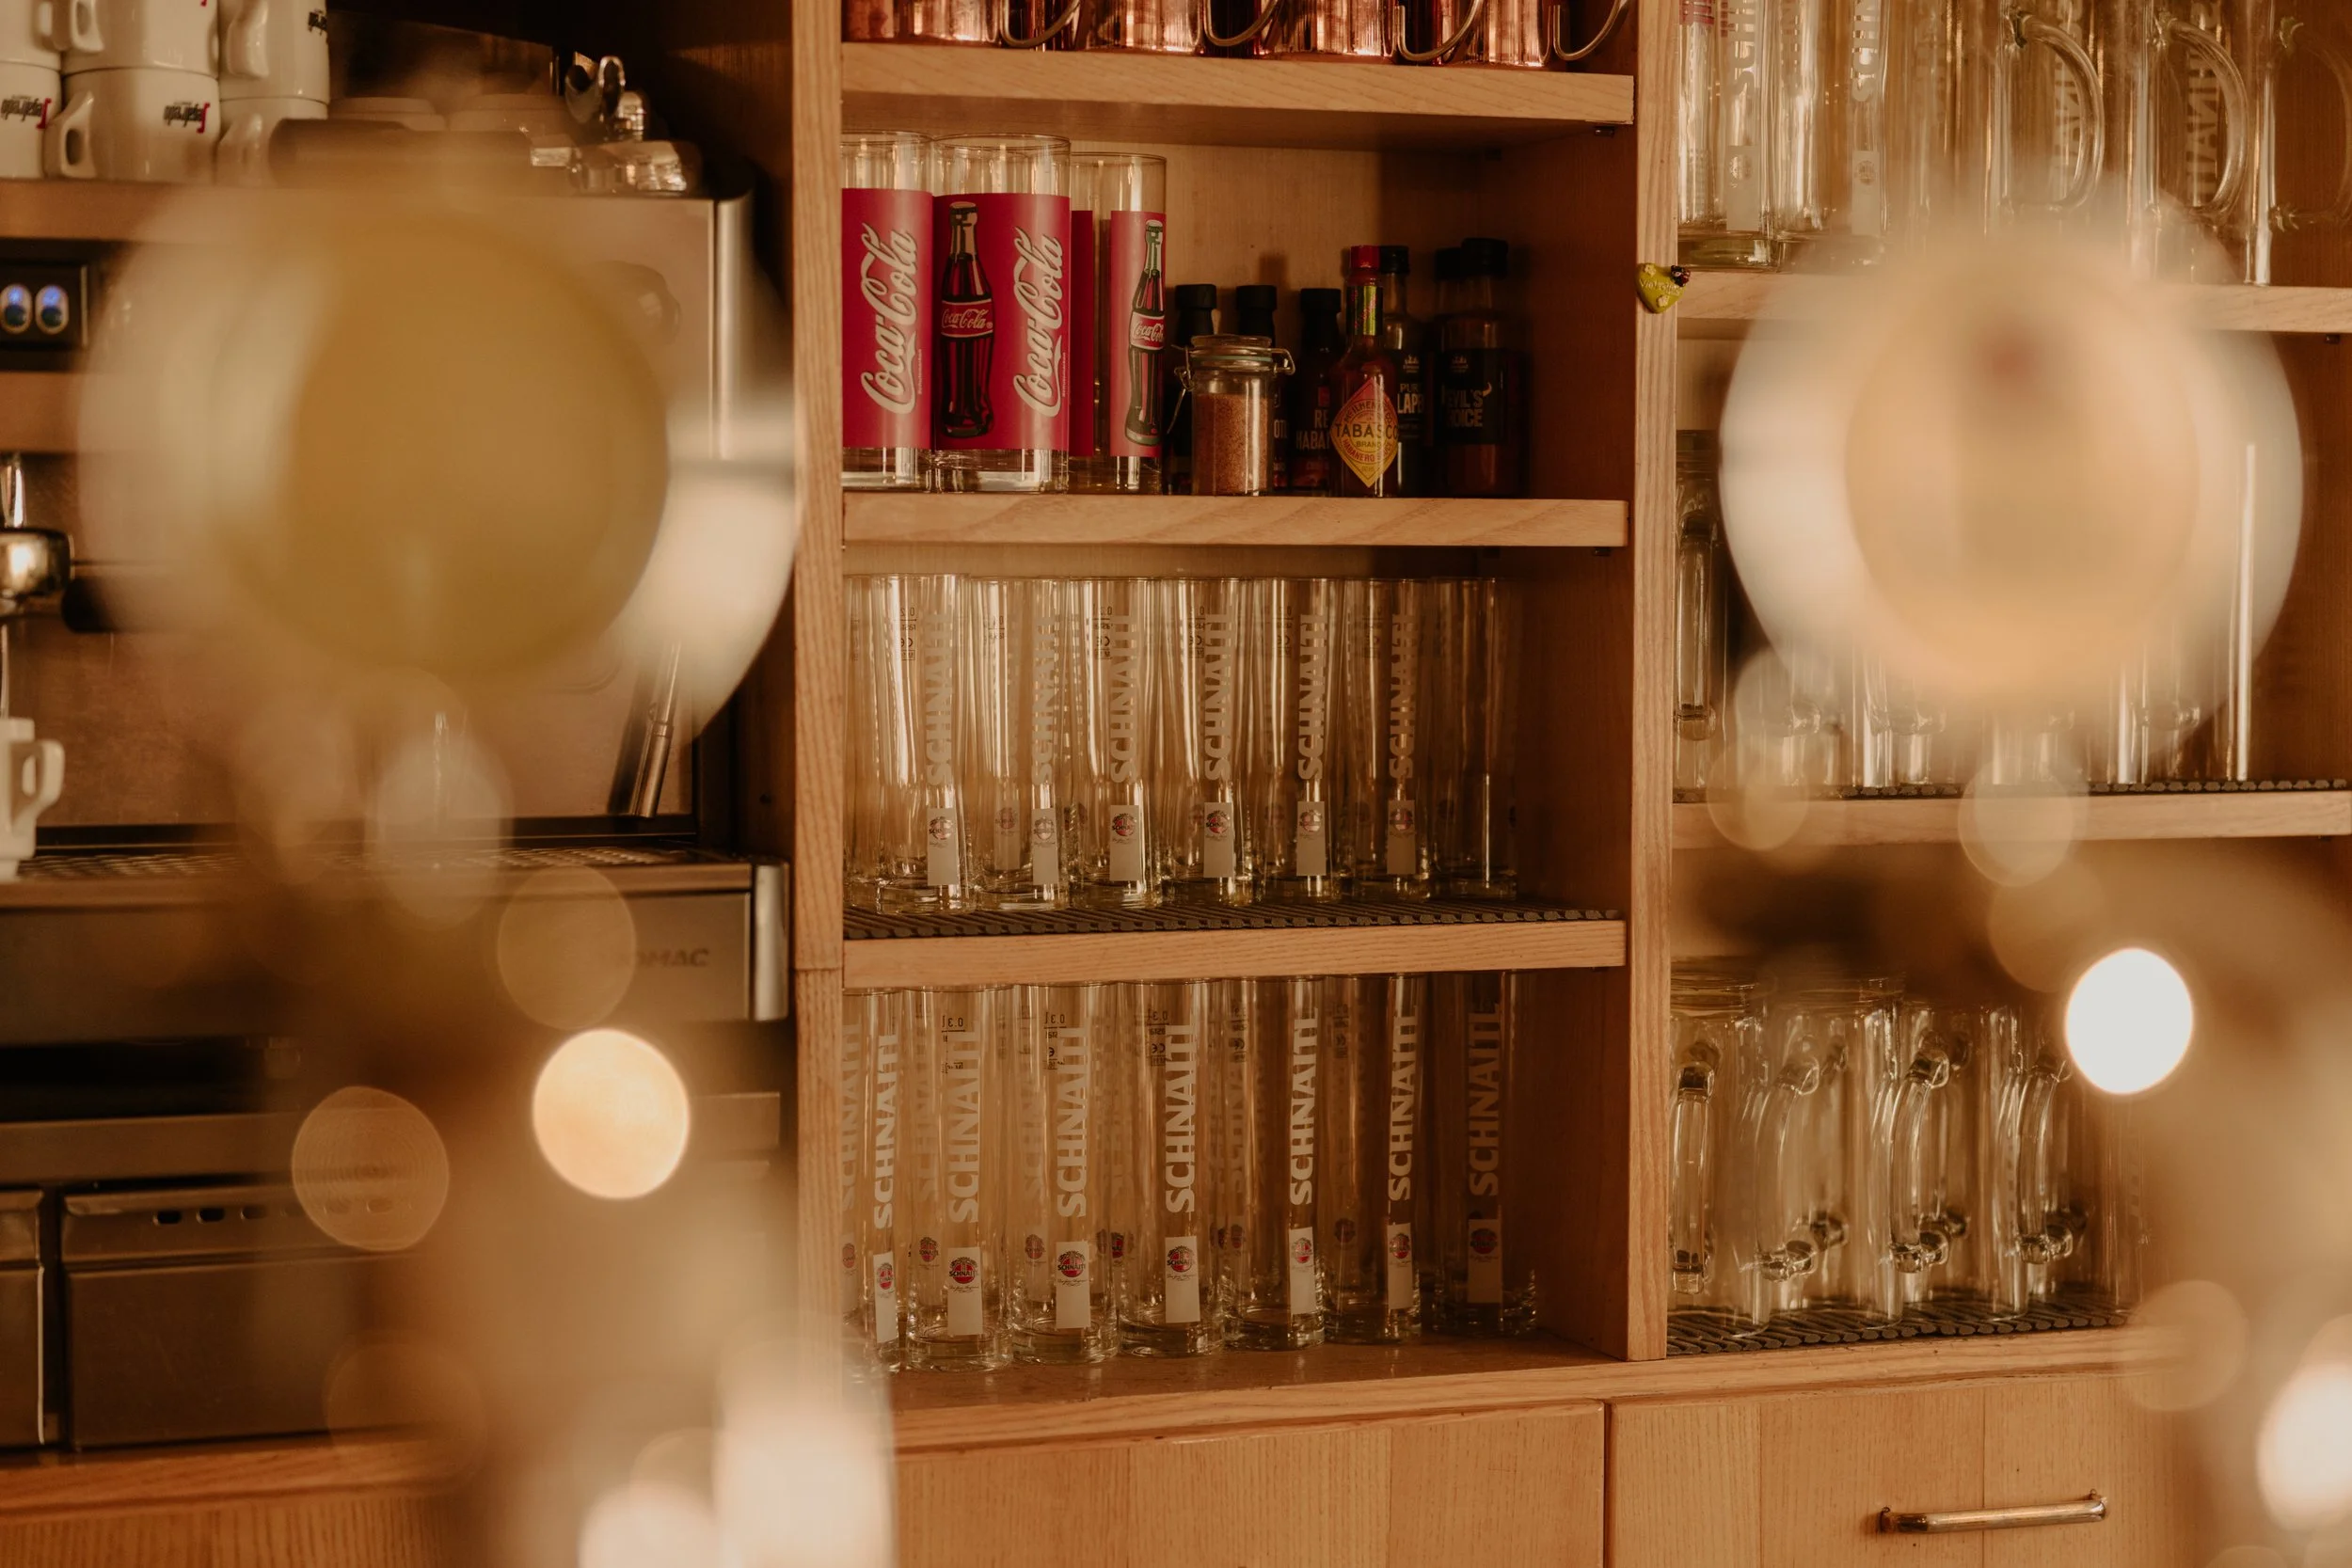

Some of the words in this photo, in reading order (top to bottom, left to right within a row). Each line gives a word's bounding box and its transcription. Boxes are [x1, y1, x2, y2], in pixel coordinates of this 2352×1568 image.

[860, 222, 918, 415] Coca-Cola
[942, 309, 989, 329] Coca-Cola
[1013, 226, 1064, 418] Coca-Cola
[1335, 422, 1399, 440] TABASCO
[925, 608, 953, 786] SCHNAITL
[1110, 610, 1138, 784] SCHNAITL
[1204, 608, 1234, 782] SCHNAITL
[1297, 607, 1327, 780] SCHNAITL
[1389, 605, 1418, 779] SCHNAITL
[874, 1025, 898, 1230] SCHNAITL
[947, 1020, 980, 1224] SCHNAITL
[1057, 1017, 1089, 1219] SCHNAITL
[1165, 1016, 1198, 1213] SCHNAITL
[1289, 1007, 1318, 1206] SCHNAITL
[1389, 1006, 1419, 1202] SCHNAITL
[1469, 1003, 1502, 1196] SCHNAITL
